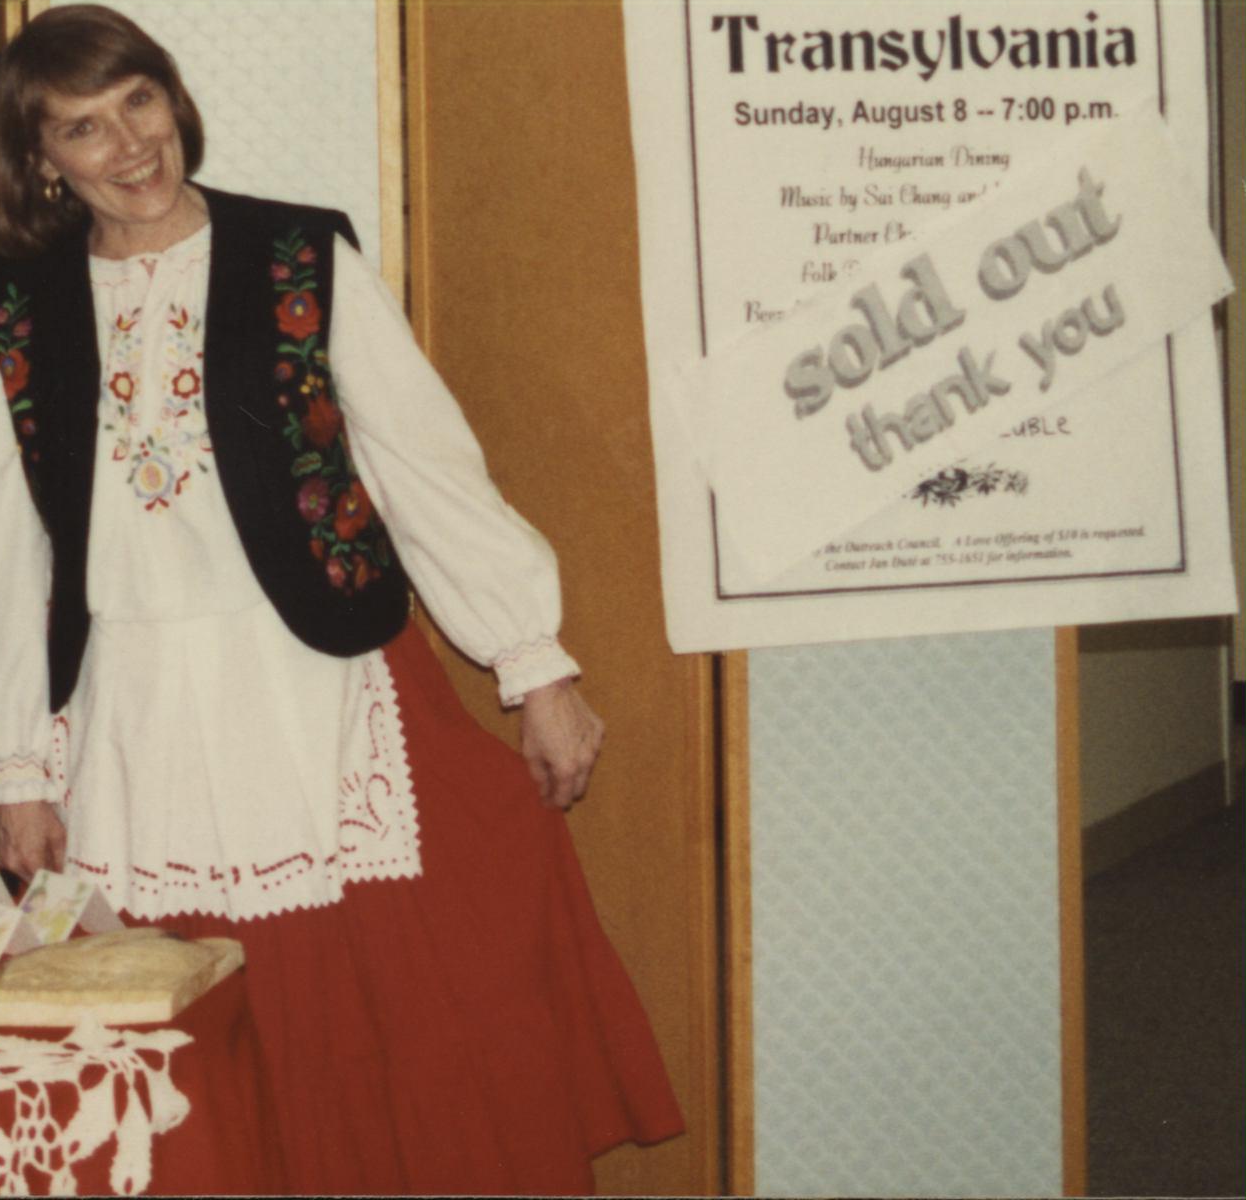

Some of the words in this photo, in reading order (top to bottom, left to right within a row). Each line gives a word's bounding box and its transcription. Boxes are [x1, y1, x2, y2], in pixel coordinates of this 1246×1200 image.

[710, 9, 1138, 81] Transylvania
[733, 100, 844, 131] Sunday,
[851, 99, 945, 129] August
[952, 98, 968, 123] 8
[1000, 96, 1056, 122] 7:00
[857, 145, 946, 173] Hungarian
[951, 145, 1012, 172] Dining
[779, 185, 833, 209] Music
[839, 184, 859, 213] by
[899, 183, 952, 210] Chang
[812, 221, 880, 246] Partner
[782, 250, 967, 421] sold
[977, 165, 1123, 302] out
[844, 343, 1013, 472] thank
[1017, 282, 1127, 392] you
